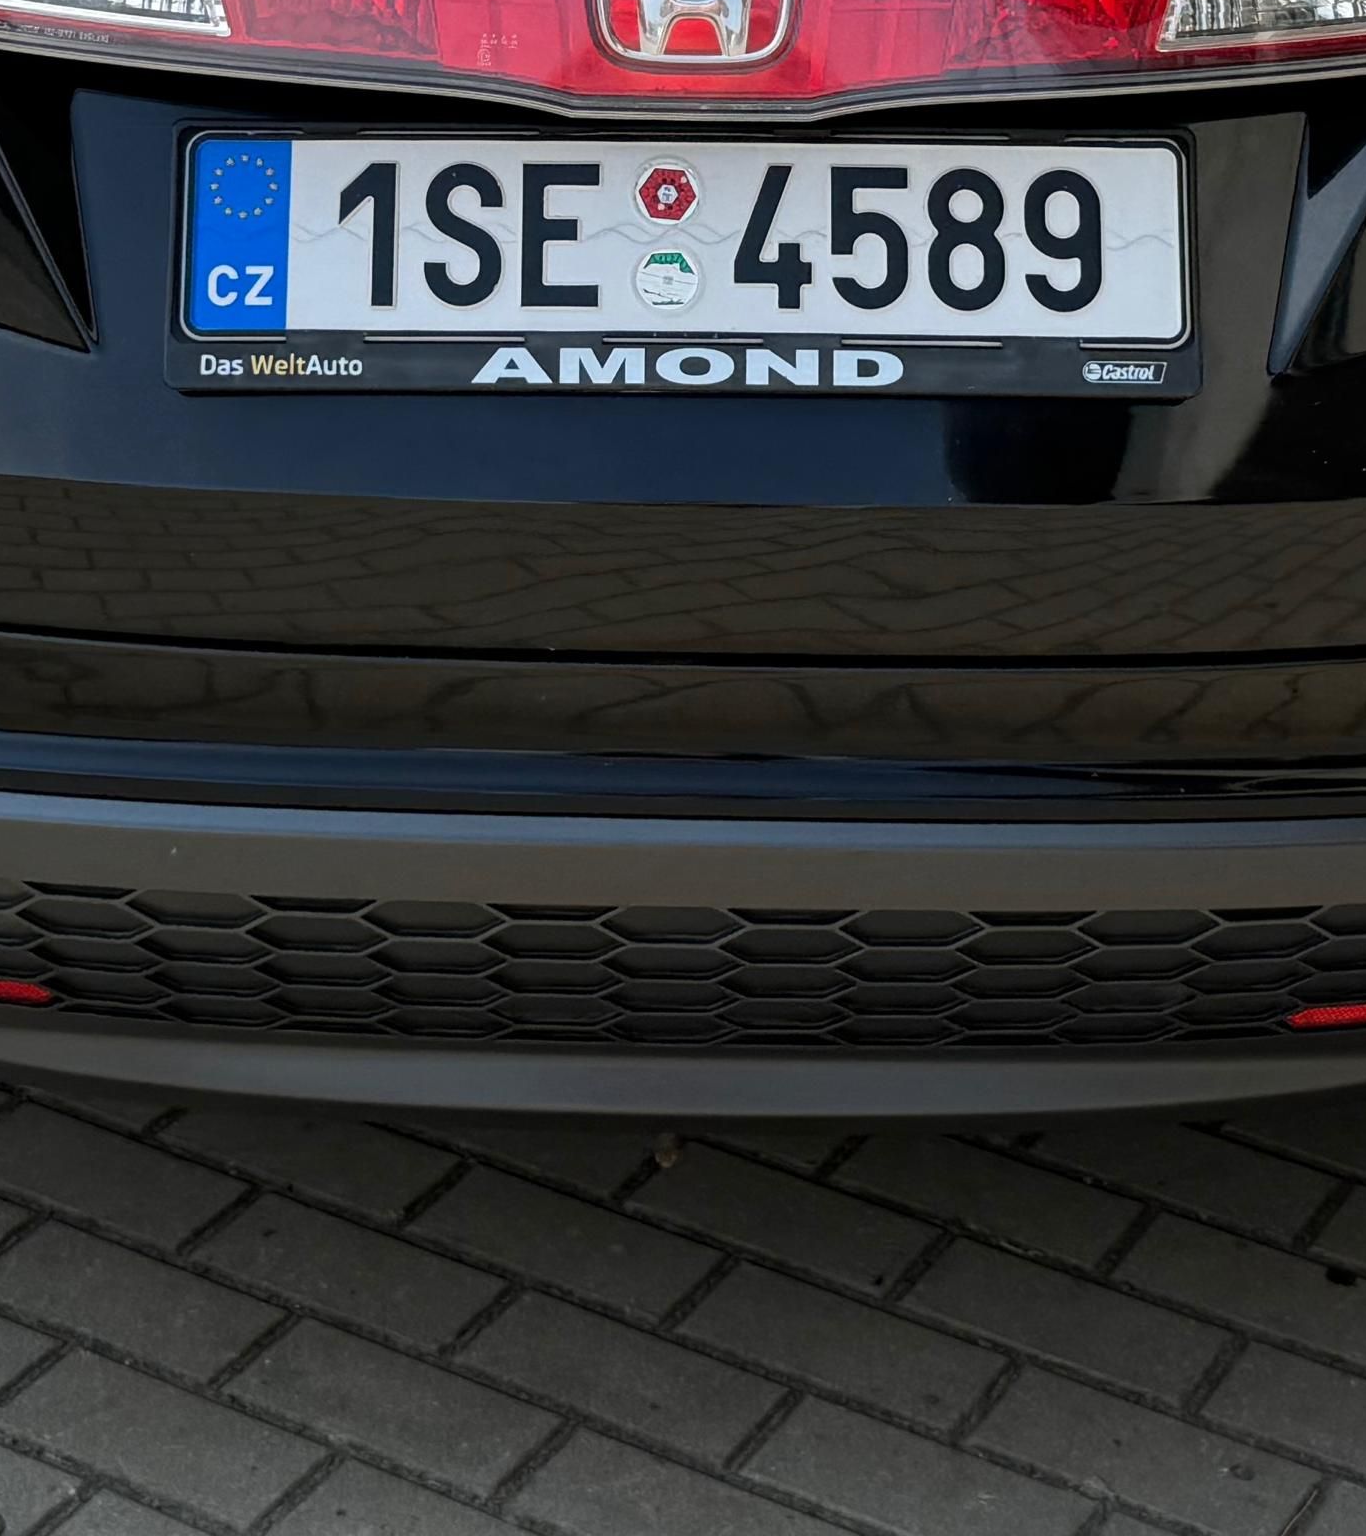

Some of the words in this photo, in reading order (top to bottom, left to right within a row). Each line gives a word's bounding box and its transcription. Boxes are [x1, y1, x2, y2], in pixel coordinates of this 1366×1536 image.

[338, 161, 602, 309] 1SE
[734, 164, 1103, 313] 4589
[207, 264, 275, 306] CZ
[200, 353, 244, 376] Das
[250, 352, 363, 376] WeltAuto
[471, 347, 904, 386] AMOND
[1102, 364, 1155, 381] Castrol
